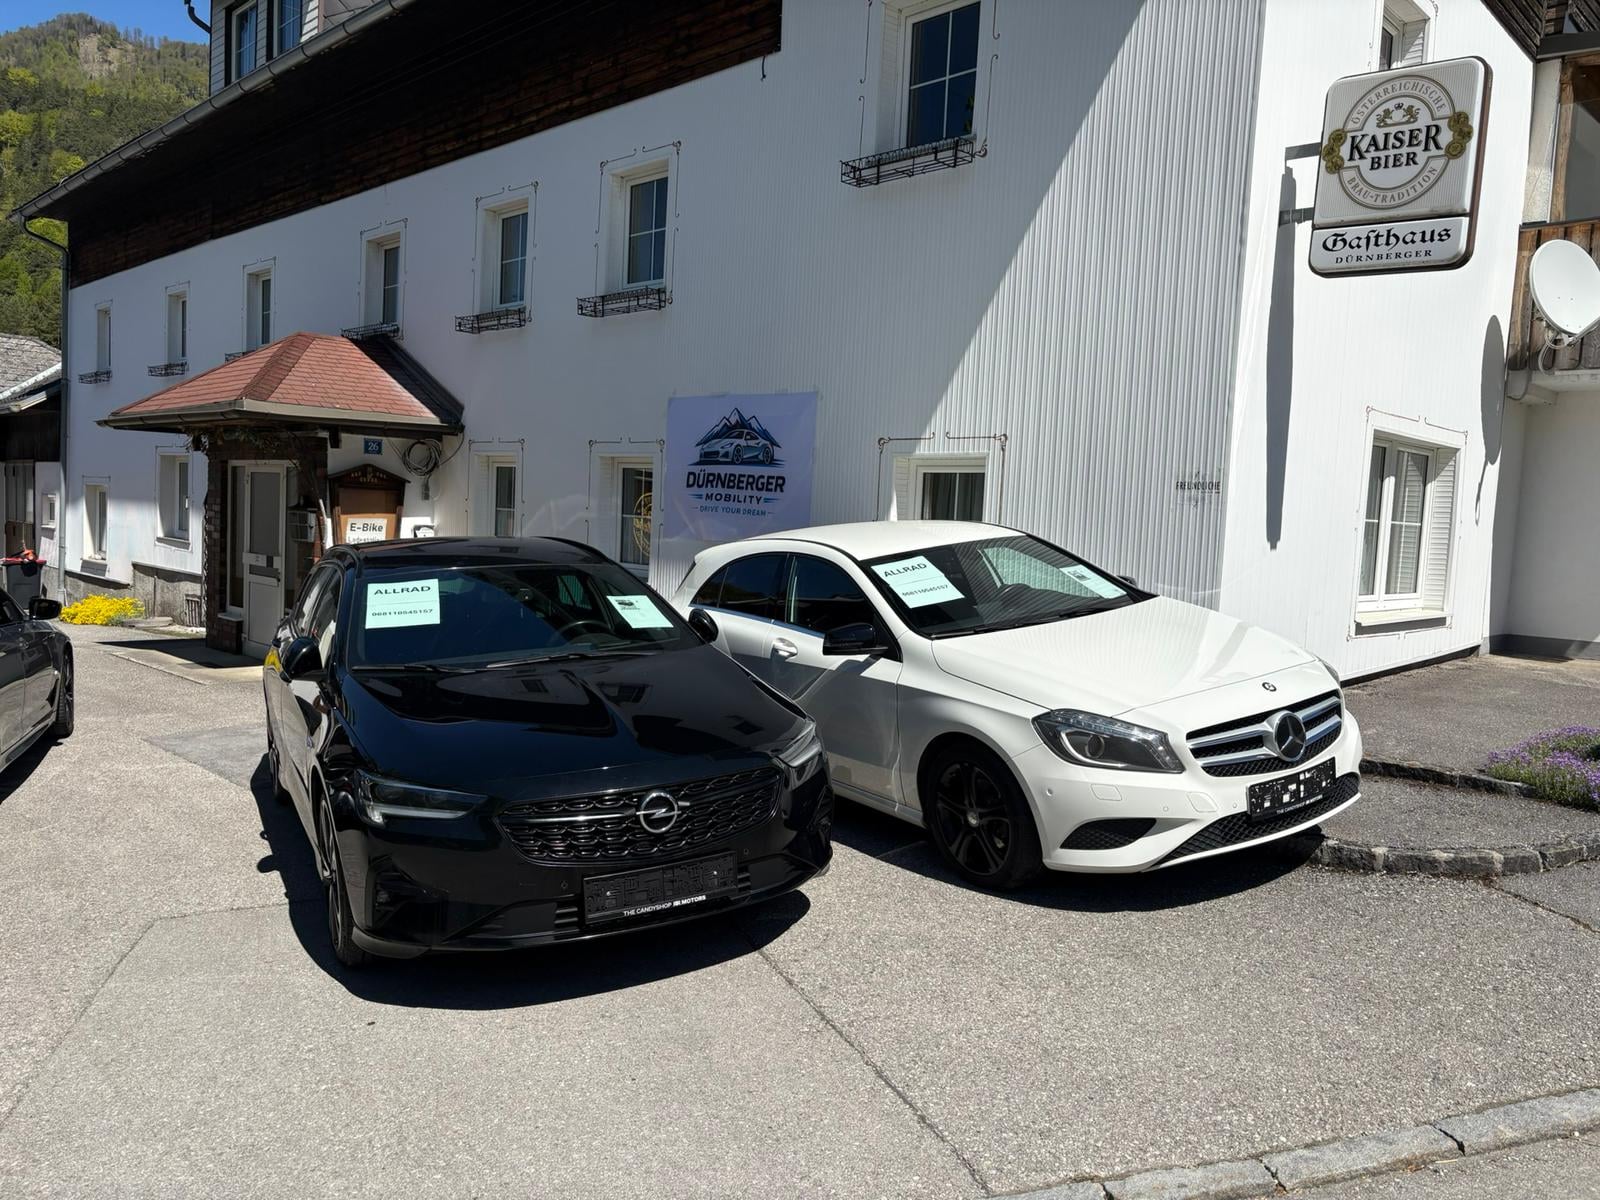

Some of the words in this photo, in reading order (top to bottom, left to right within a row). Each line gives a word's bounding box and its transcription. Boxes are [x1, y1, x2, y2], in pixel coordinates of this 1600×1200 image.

[1350, 81, 1447, 124] ÖSTERREICHISCHE
[1347, 124, 1443, 162] KAISER
[1369, 152, 1419, 171] BIER
[1335, 249, 1433, 264] DÜRNBERGER
[368, 441, 379, 451] 26
[686, 468, 786, 493] DÜRNBERGER
[704, 492, 763, 505] MOBILITY
[699, 505, 719, 513] DRIVE
[720, 506, 741, 514] YOUR
[742, 508, 767, 517] DREAM
[350, 522, 384, 532] E-Bike
[883, 562, 927, 578] ALLRAD
[374, 585, 431, 596] ALLRAD
[623, 909, 636, 917] THE
[637, 902, 671, 914] CANDYSHOP
